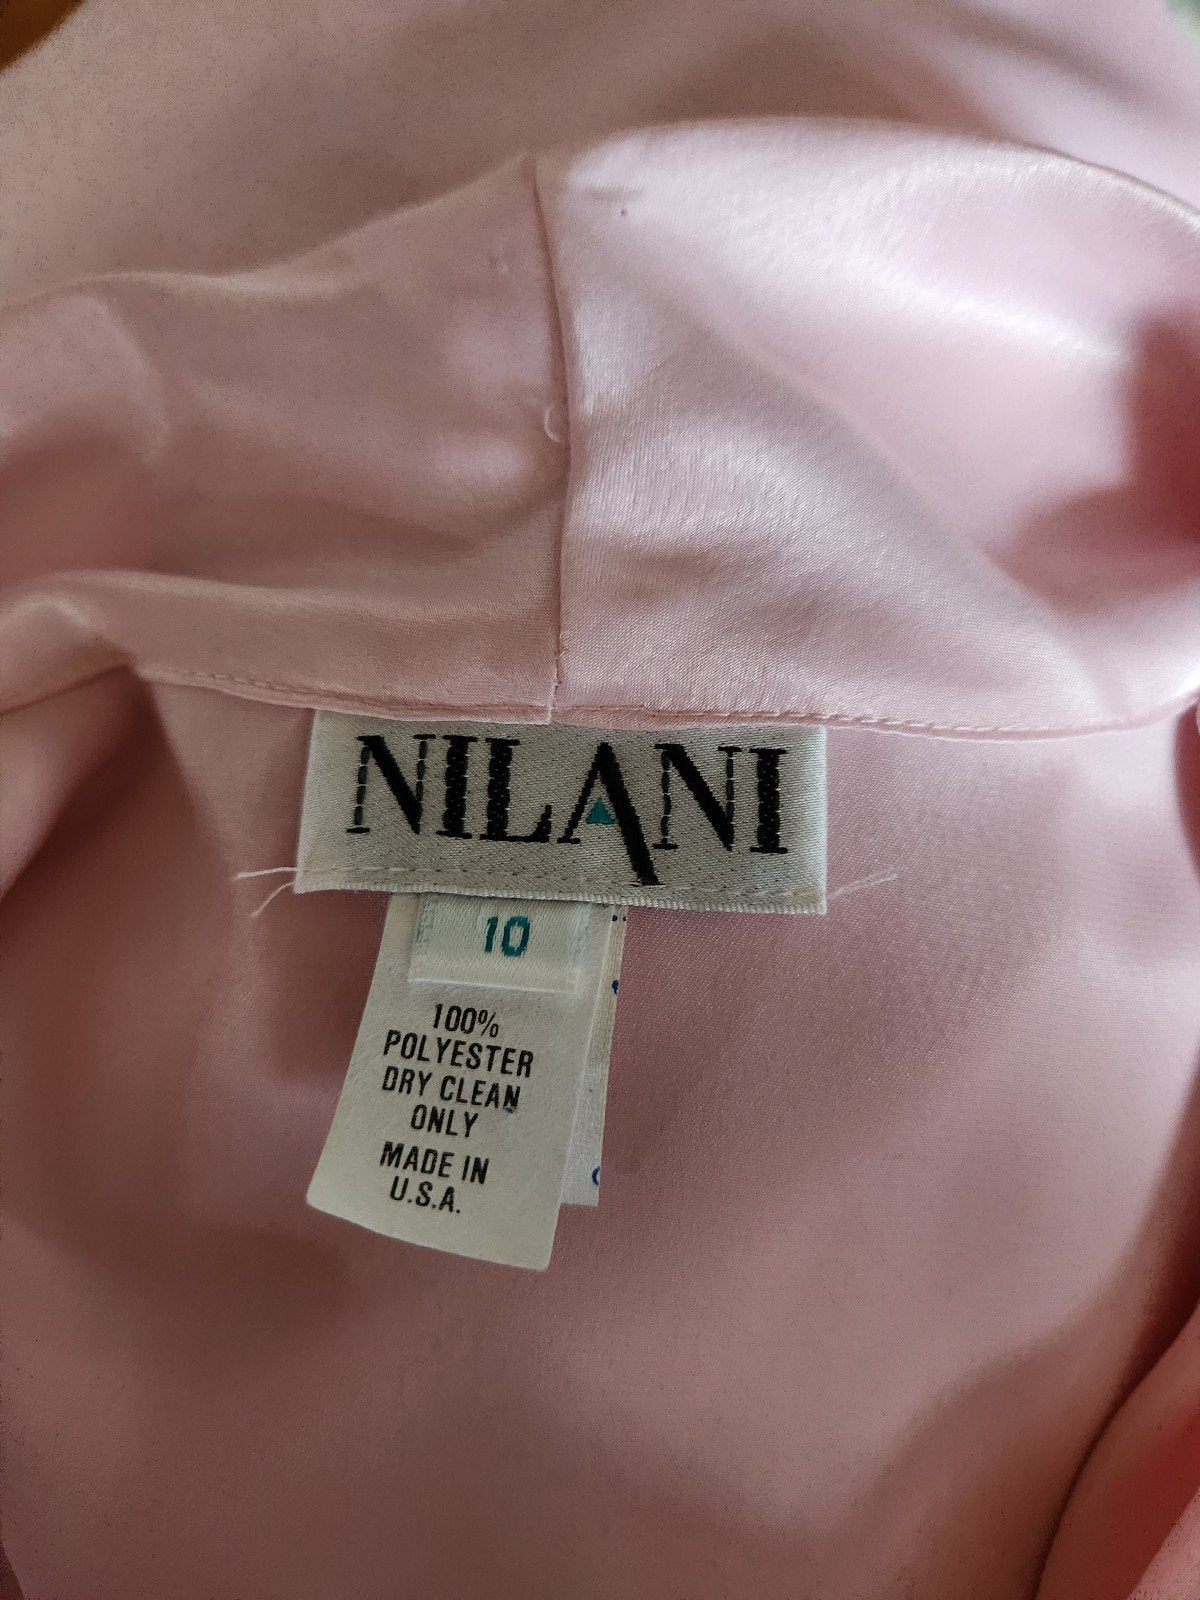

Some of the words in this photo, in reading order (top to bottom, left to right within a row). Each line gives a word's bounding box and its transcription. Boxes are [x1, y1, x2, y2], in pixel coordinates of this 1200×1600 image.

[346, 734, 789, 887] NILANI
[484, 915, 531, 957] 10
[432, 1003, 500, 1038] 100%
[382, 1029, 535, 1078] POLYESTER
[382, 1066, 433, 1097] DRY
[440, 1075, 521, 1110] CLEAN
[410, 1104, 479, 1138] ONLY
[379, 1141, 453, 1178] MADE
[462, 1156, 490, 1185] IN
[390, 1176, 461, 1214] U.S.A.
